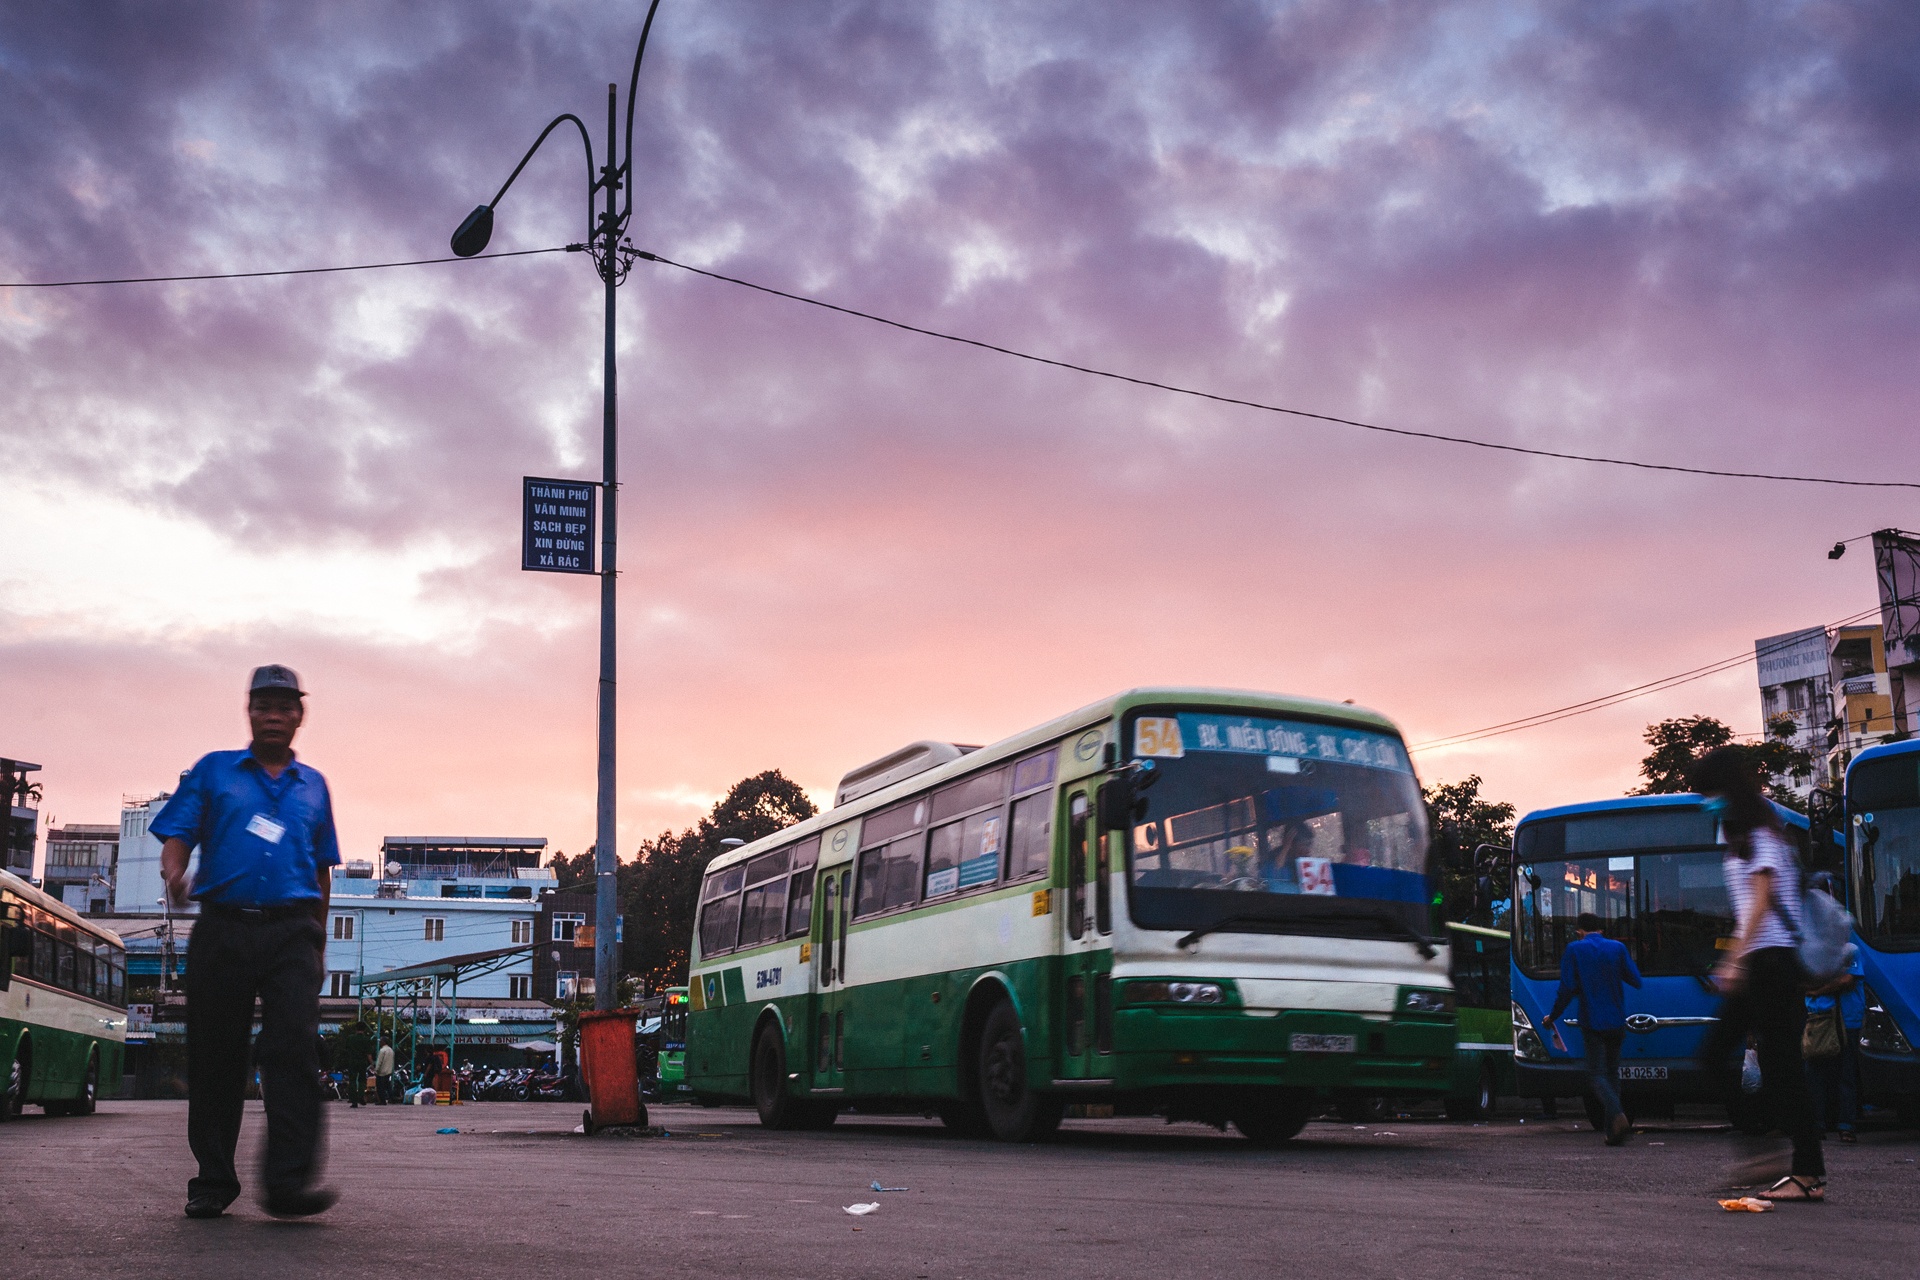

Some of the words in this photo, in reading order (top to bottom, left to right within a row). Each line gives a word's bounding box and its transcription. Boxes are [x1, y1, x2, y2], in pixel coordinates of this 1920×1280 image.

[531, 486, 565, 499] THÀNH
[569, 488, 590, 501] PHỐ
[534, 503, 556, 515] VĂN
[560, 506, 586, 517] MINH
[533, 520, 561, 534] SẠCH
[565, 523, 586, 536] ĐẸP
[535, 537, 553, 549] XIN
[540, 552, 554, 566] XẢ
[558, 555, 579, 568] RÁC
[1802, 650, 1826, 664] NAM
[1140, 719, 1180, 755] 54
[1301, 861, 1333, 891] 54
[495, 1036, 519, 1044] SINH
